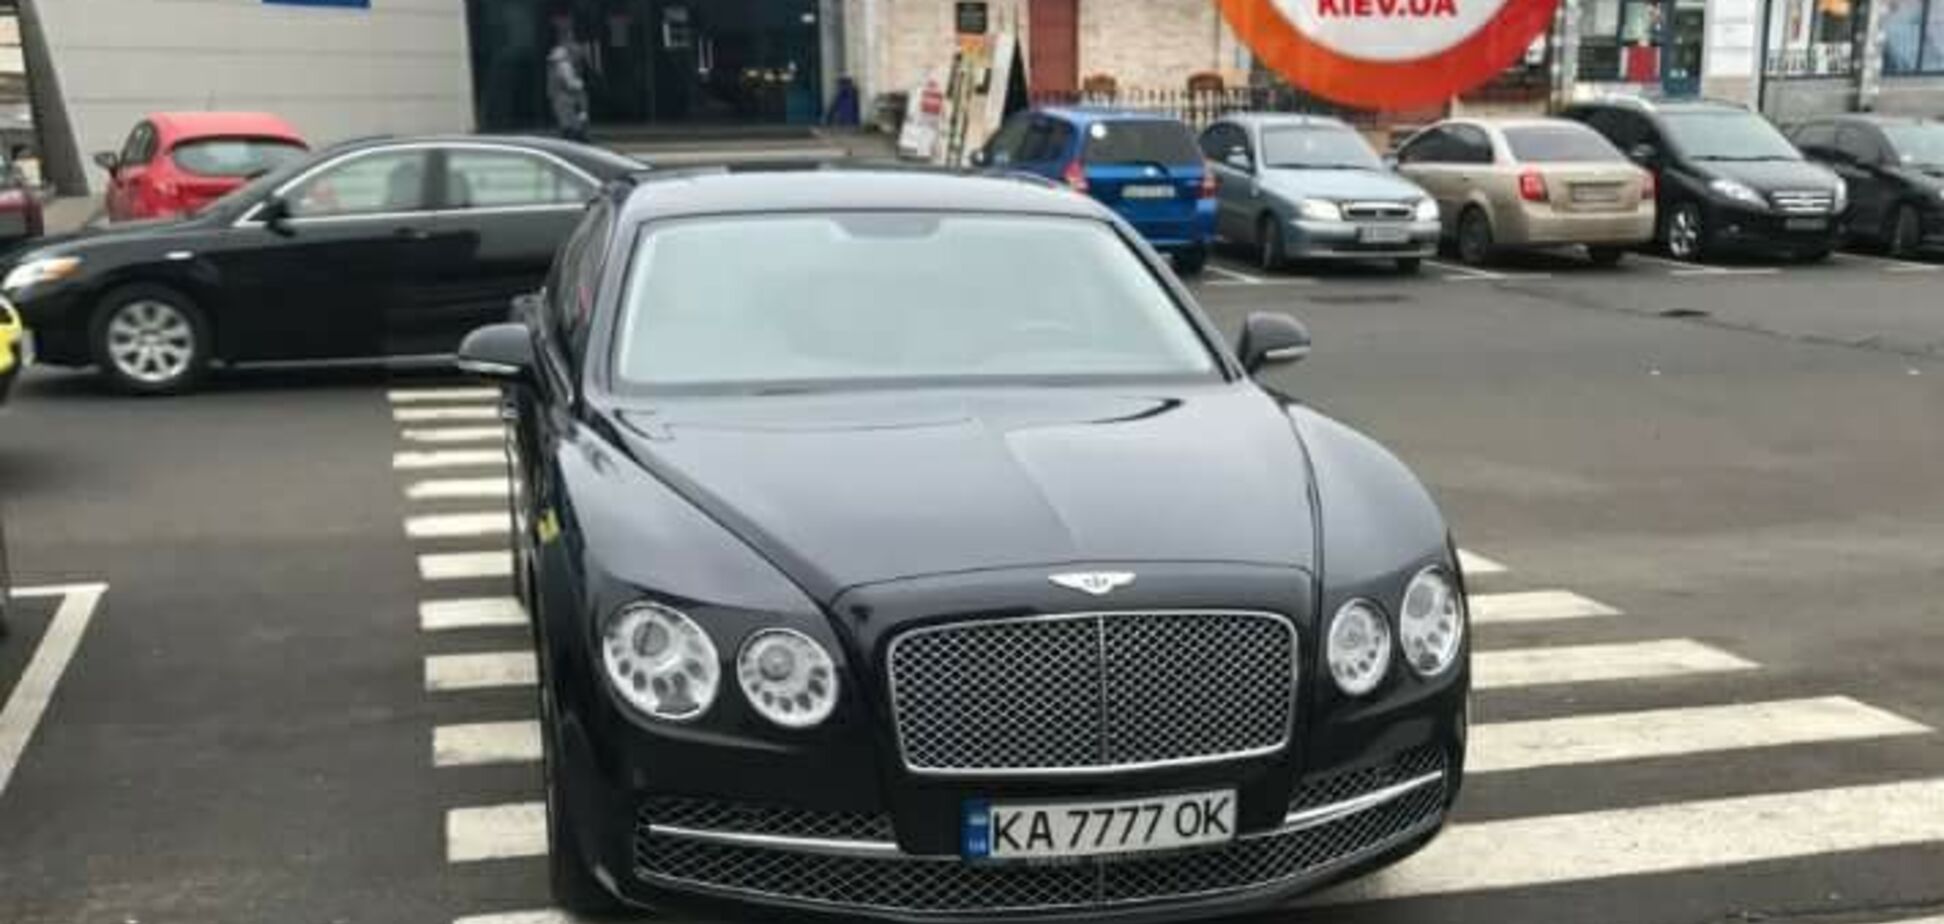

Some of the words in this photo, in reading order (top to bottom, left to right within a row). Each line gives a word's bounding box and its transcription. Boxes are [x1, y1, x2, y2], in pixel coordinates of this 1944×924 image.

[993, 811, 1054, 850] KA
[1067, 805, 1164, 848] 7777
[1174, 798, 1230, 838] OK
